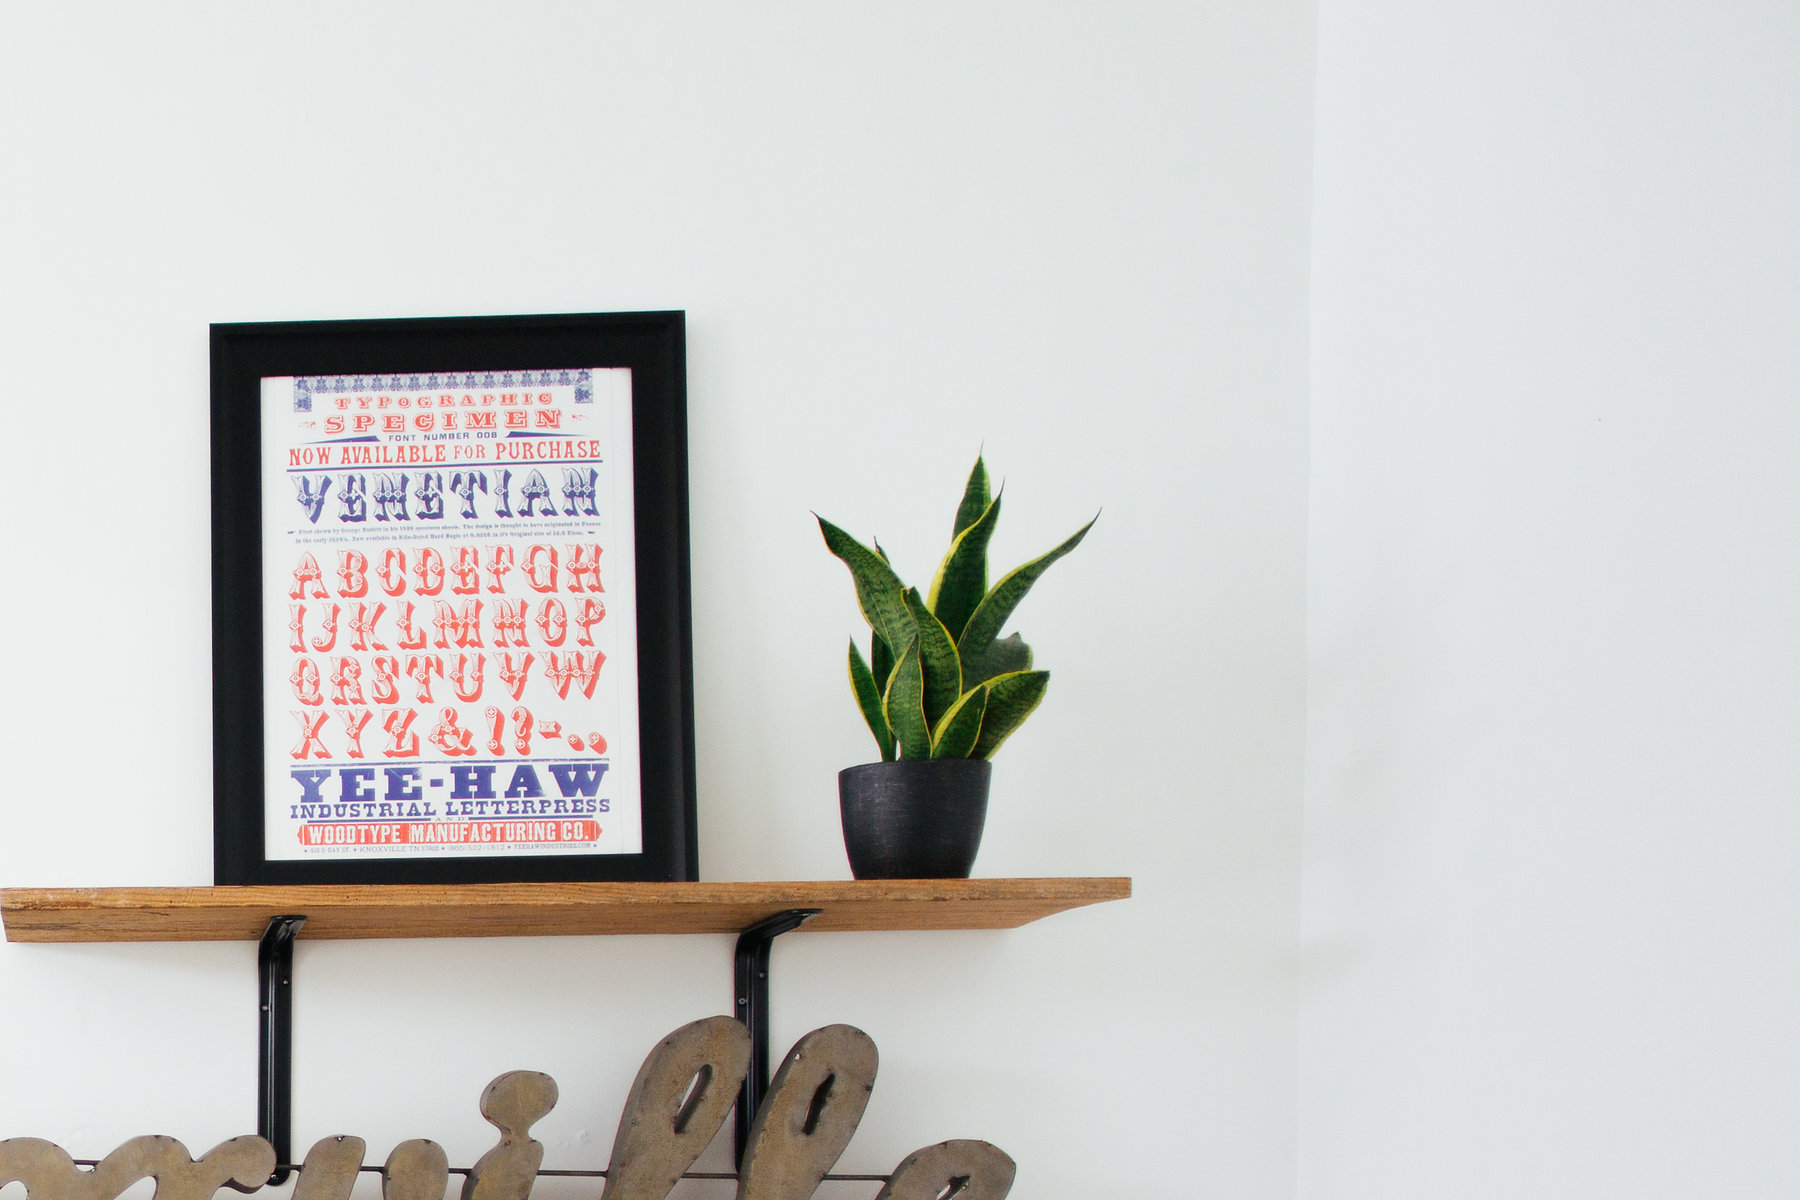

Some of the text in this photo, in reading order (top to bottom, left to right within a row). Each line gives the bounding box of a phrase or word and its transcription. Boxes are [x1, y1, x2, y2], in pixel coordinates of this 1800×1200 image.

[334, 392, 552, 410] TYPOGRAPHIC
[324, 409, 562, 433] SPECIMEN
[388, 434, 417, 442] FONT
[423, 432, 470, 441] NUMBER
[289, 440, 601, 466] NOW AVAILABLE FOR PURCHASE
[291, 467, 601, 524] VENETIAN
[290, 763, 610, 803] YEE-HAW
[290, 798, 610, 819] INDUSTRIAL LETTERPRESS
[308, 820, 589, 844] WOODTYPE MANUFACTURING CO.
[359, 844, 407, 853] KNOXVILLE
